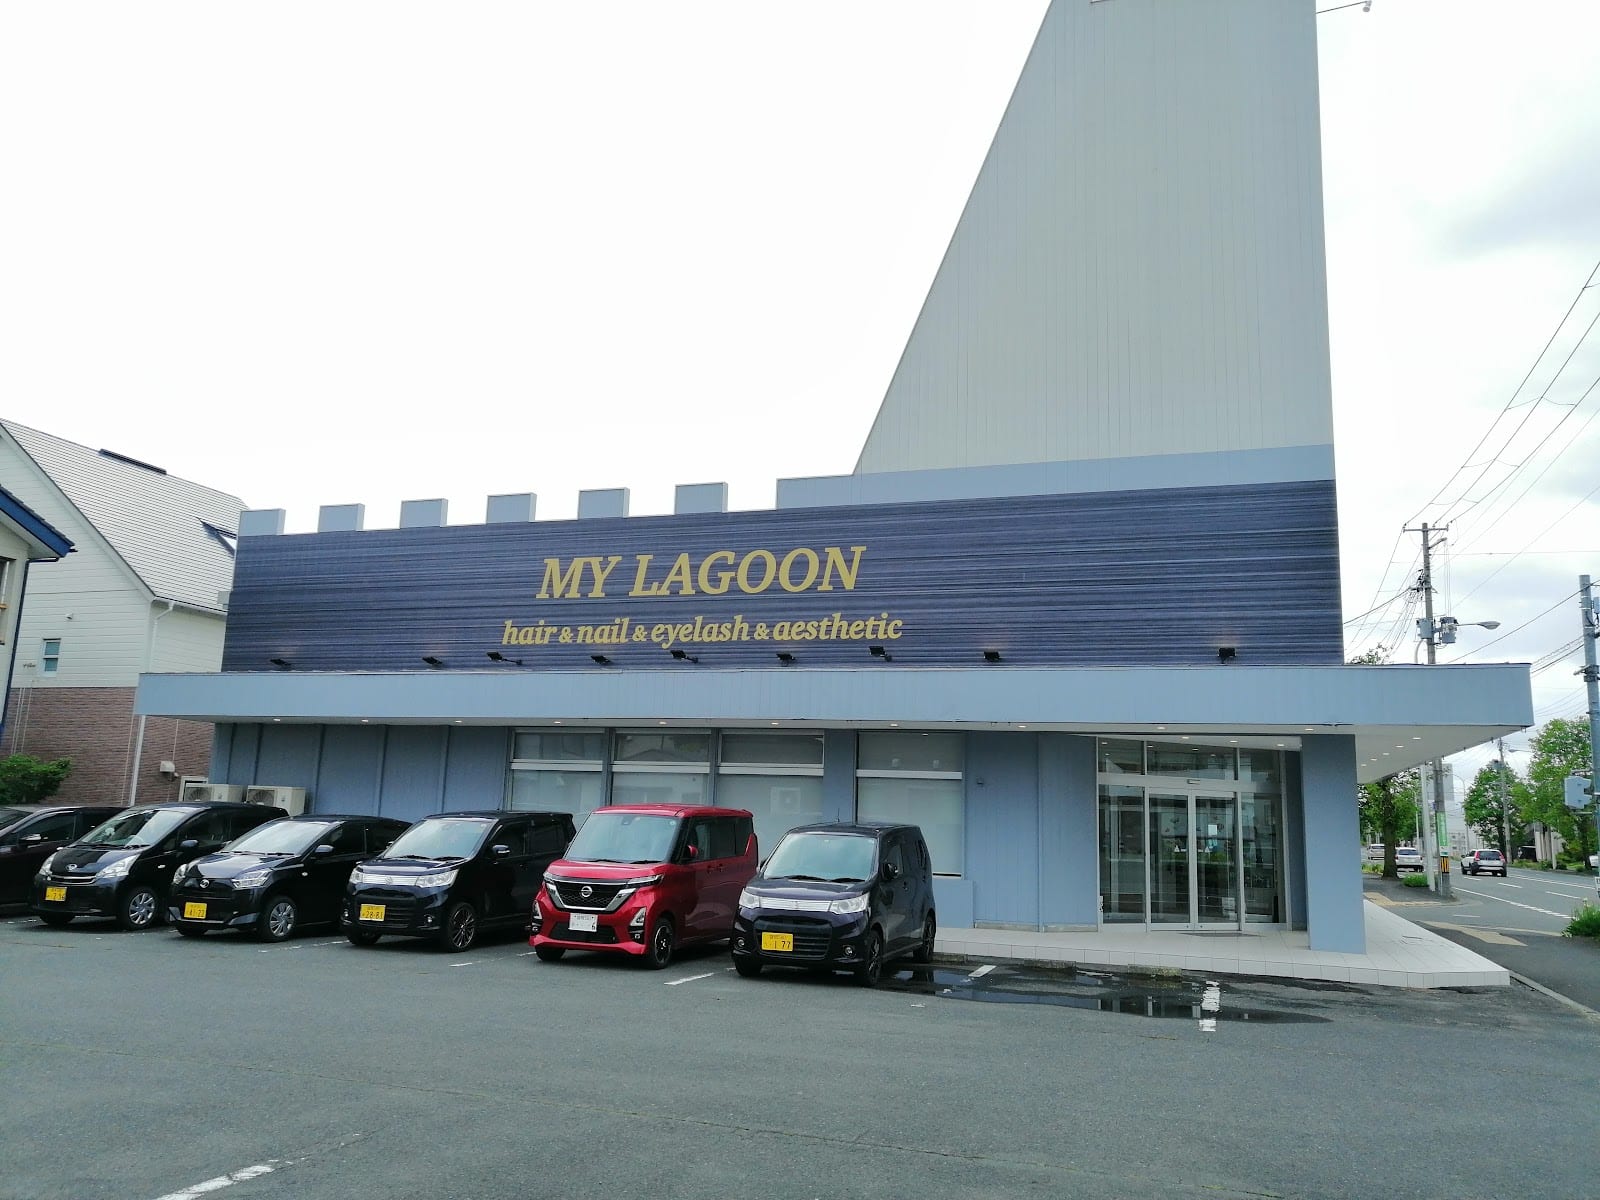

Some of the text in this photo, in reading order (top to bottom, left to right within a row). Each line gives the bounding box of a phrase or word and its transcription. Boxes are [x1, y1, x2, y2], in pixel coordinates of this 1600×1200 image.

[535, 545, 867, 599] MY LAGOON
[502, 612, 903, 649] hair & nail & eyelash & aesthetic
